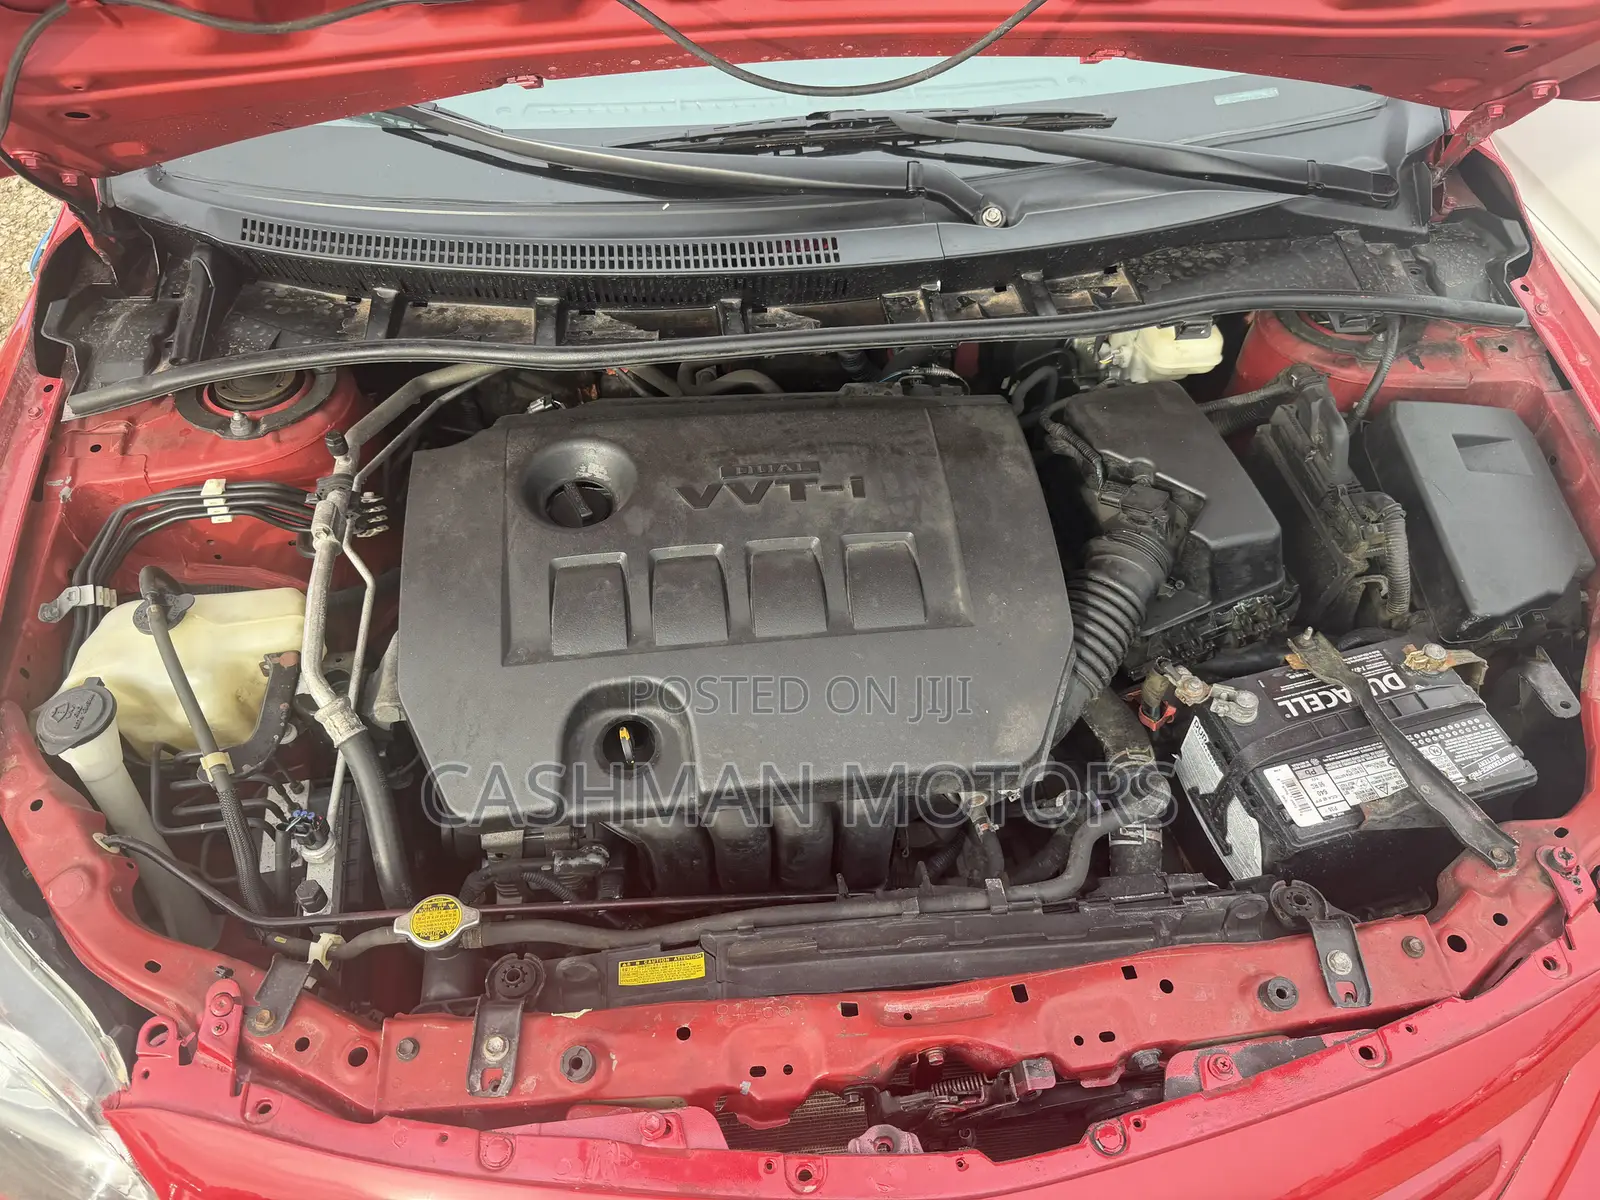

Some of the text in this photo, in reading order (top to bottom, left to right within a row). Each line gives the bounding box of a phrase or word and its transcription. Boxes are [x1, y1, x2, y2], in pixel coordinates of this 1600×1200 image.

[735, 463, 812, 475] DUAL
[1277, 672, 1407, 718] DUACELL
[644, 957, 670, 965] CAUTION
[673, 953, 704, 962] ATTENTION
